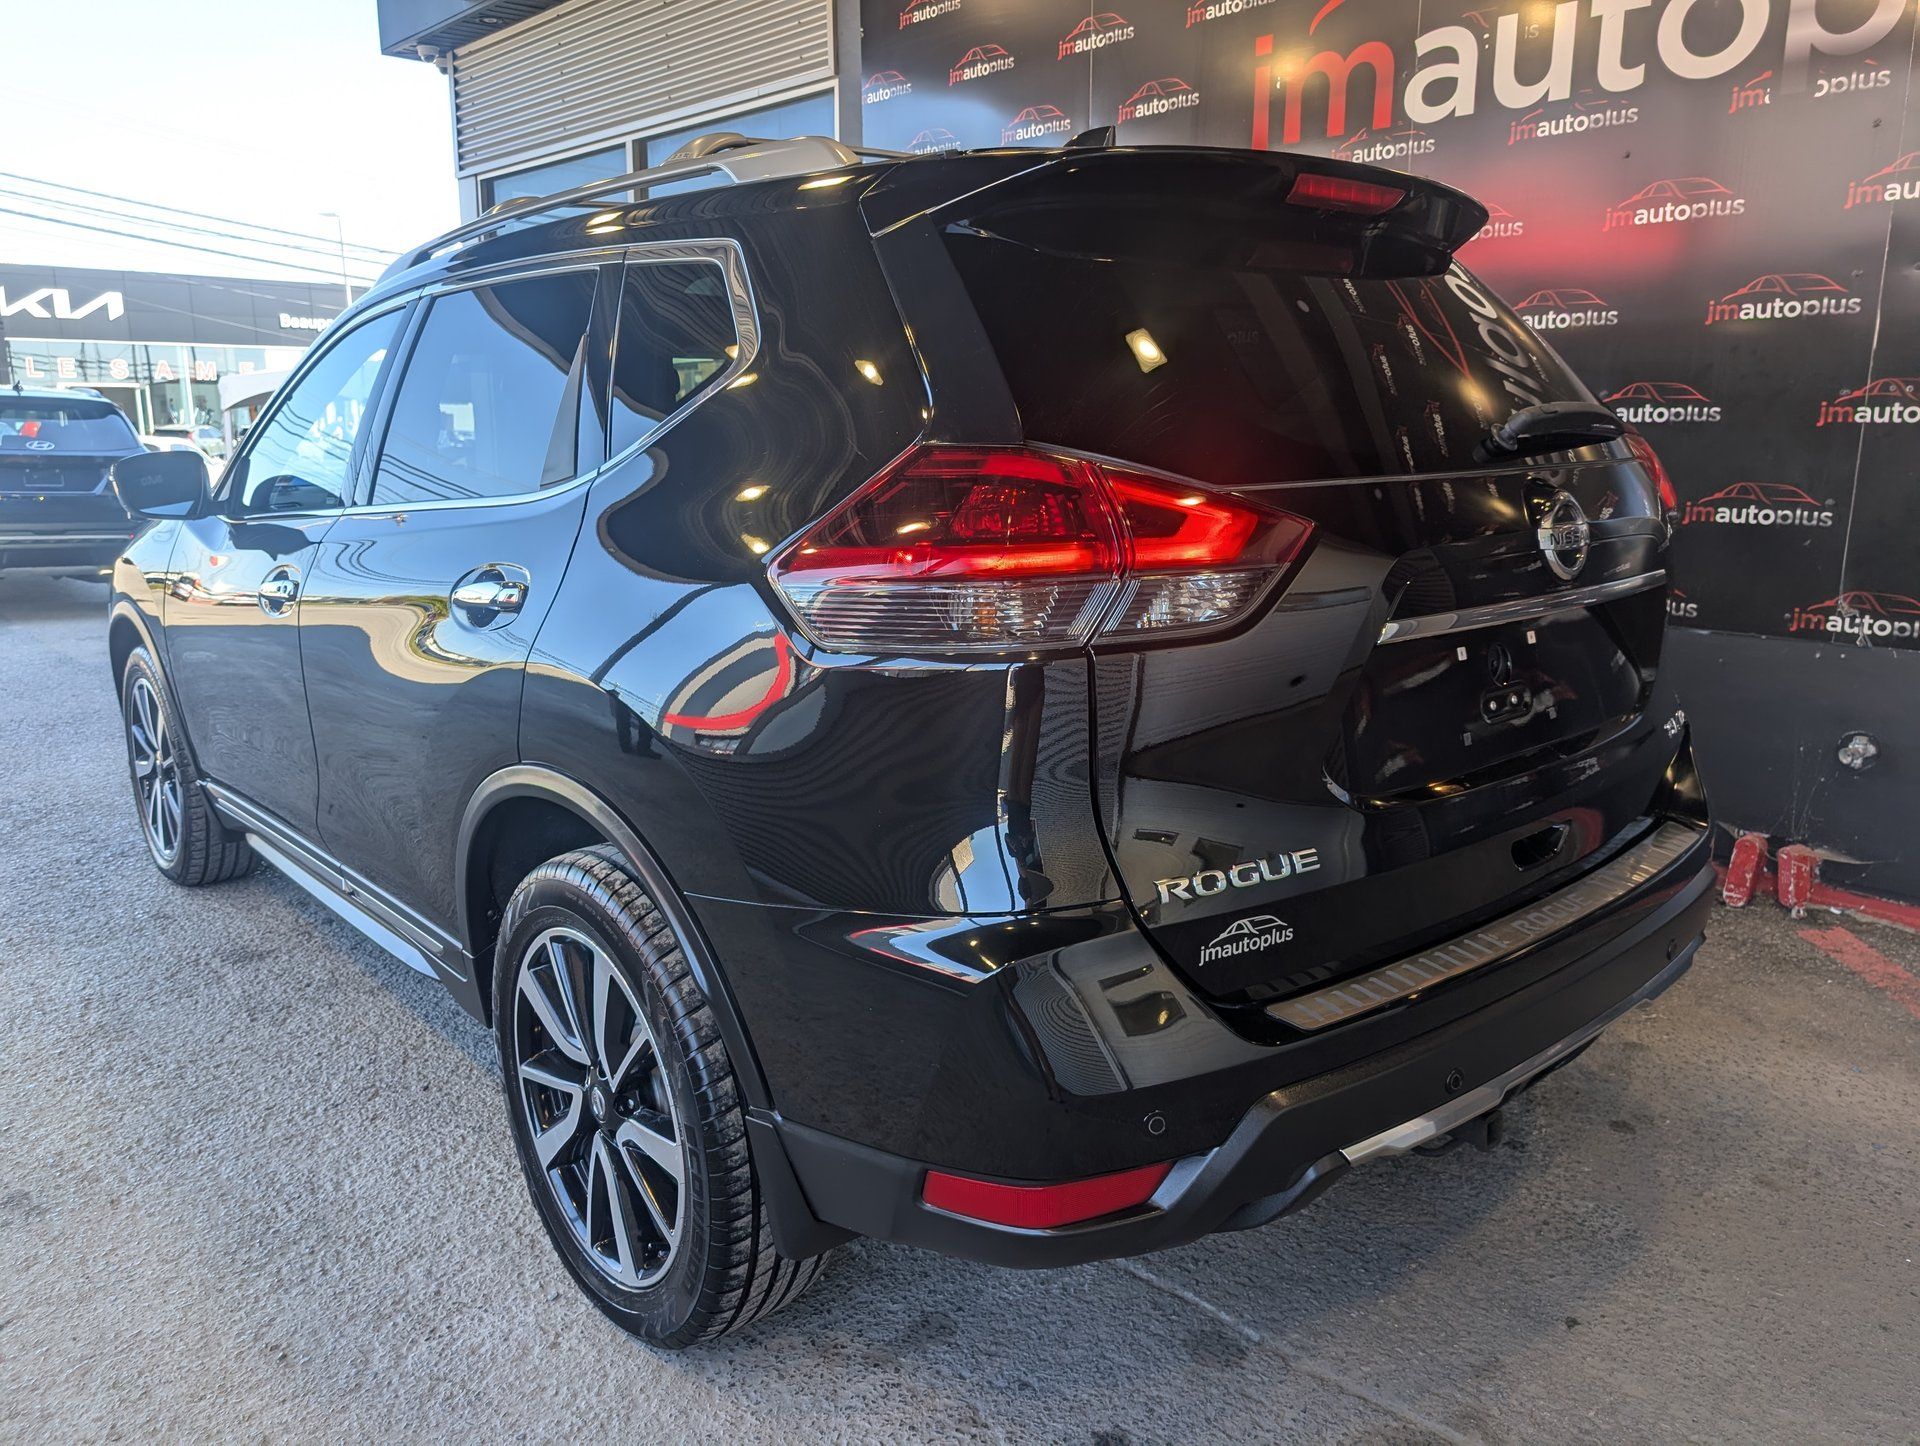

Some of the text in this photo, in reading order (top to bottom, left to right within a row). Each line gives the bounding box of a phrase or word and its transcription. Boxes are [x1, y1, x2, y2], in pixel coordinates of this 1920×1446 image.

[899, 0, 961, 30] jmautoplus
[1186, 0, 1277, 29] jmautop
[1058, 25, 1135, 61] jmautoplus
[949, 56, 1015, 87] jmautoplus
[1118, 91, 1200, 125] jmautoplus
[1001, 118, 1071, 146] jmautoplus
[1508, 107, 1639, 146] jmautoplus
[1602, 198, 1745, 232] jmautoplus
[1705, 296, 1862, 325] jmautoplus
[1682, 501, 1833, 527] jmautoplus
[1153, 847, 1321, 904] ROGUE
[1199, 926, 1294, 966] jmautoplus
